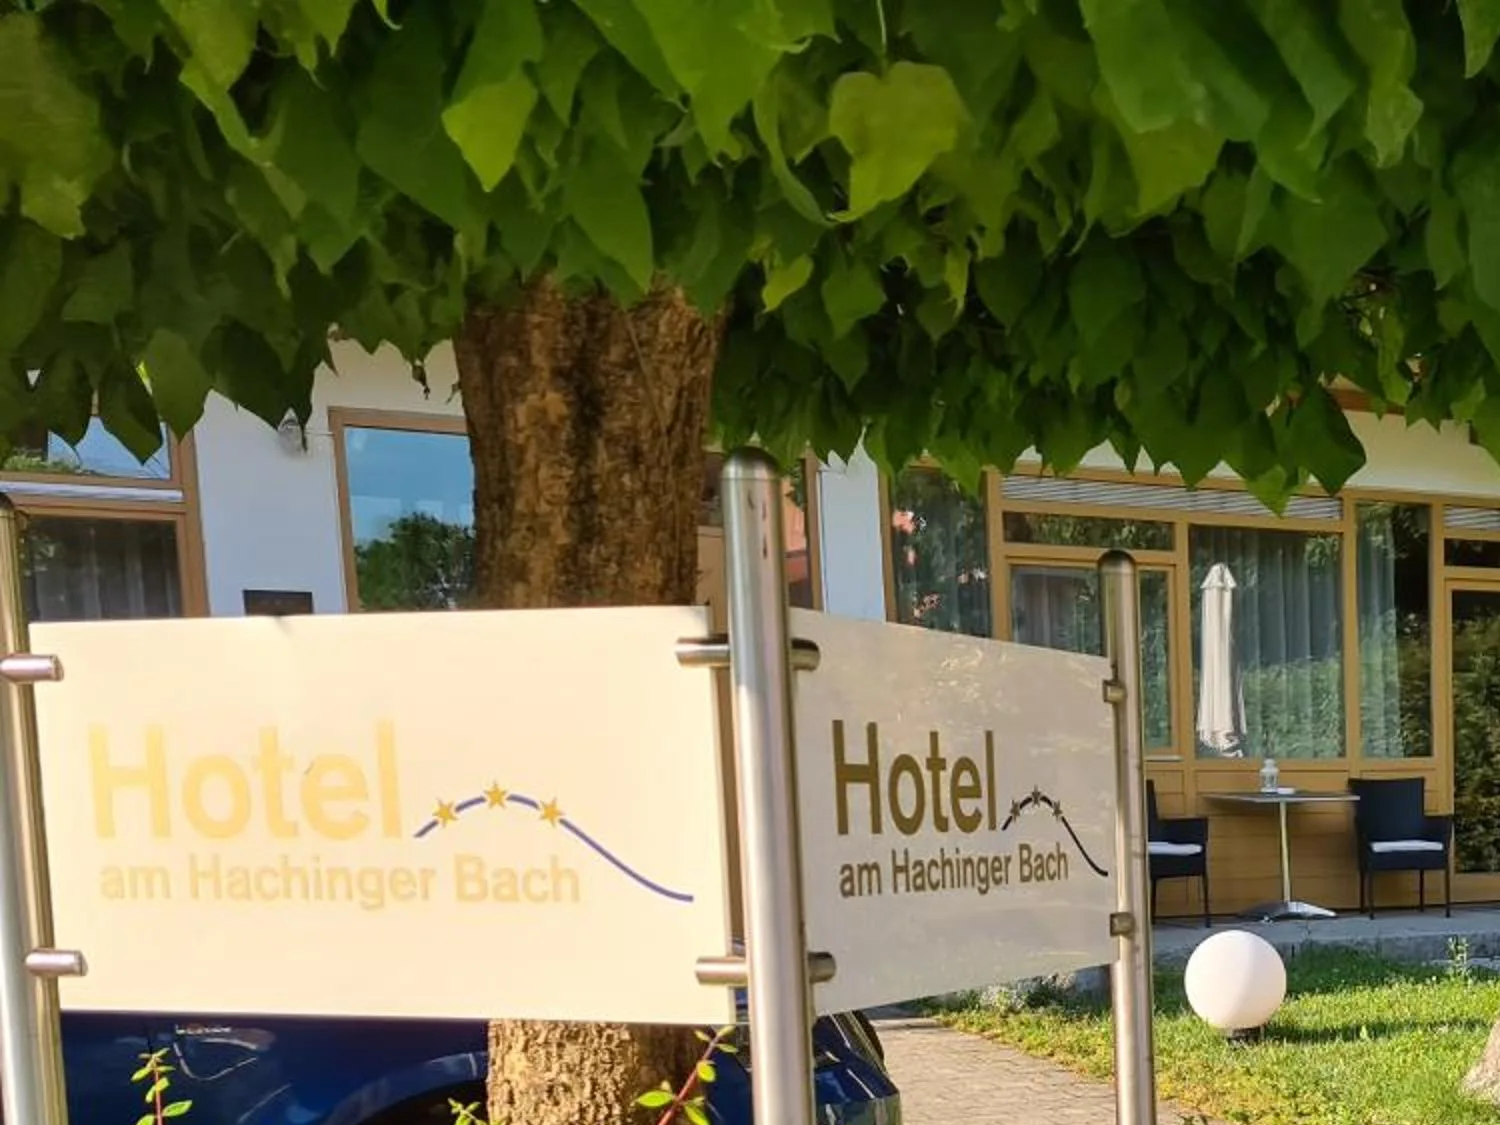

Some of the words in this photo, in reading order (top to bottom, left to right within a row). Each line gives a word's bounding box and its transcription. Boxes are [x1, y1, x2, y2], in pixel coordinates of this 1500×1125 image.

[88, 721, 400, 840] Hotel
[832, 719, 997, 835] Hotel
[100, 862, 171, 901] am
[189, 854, 435, 910] Hachinger
[455, 853, 582, 903] Bach
[839, 862, 881, 899] am
[891, 848, 1012, 896] Hachinger
[1018, 842, 1069, 883] Bach
